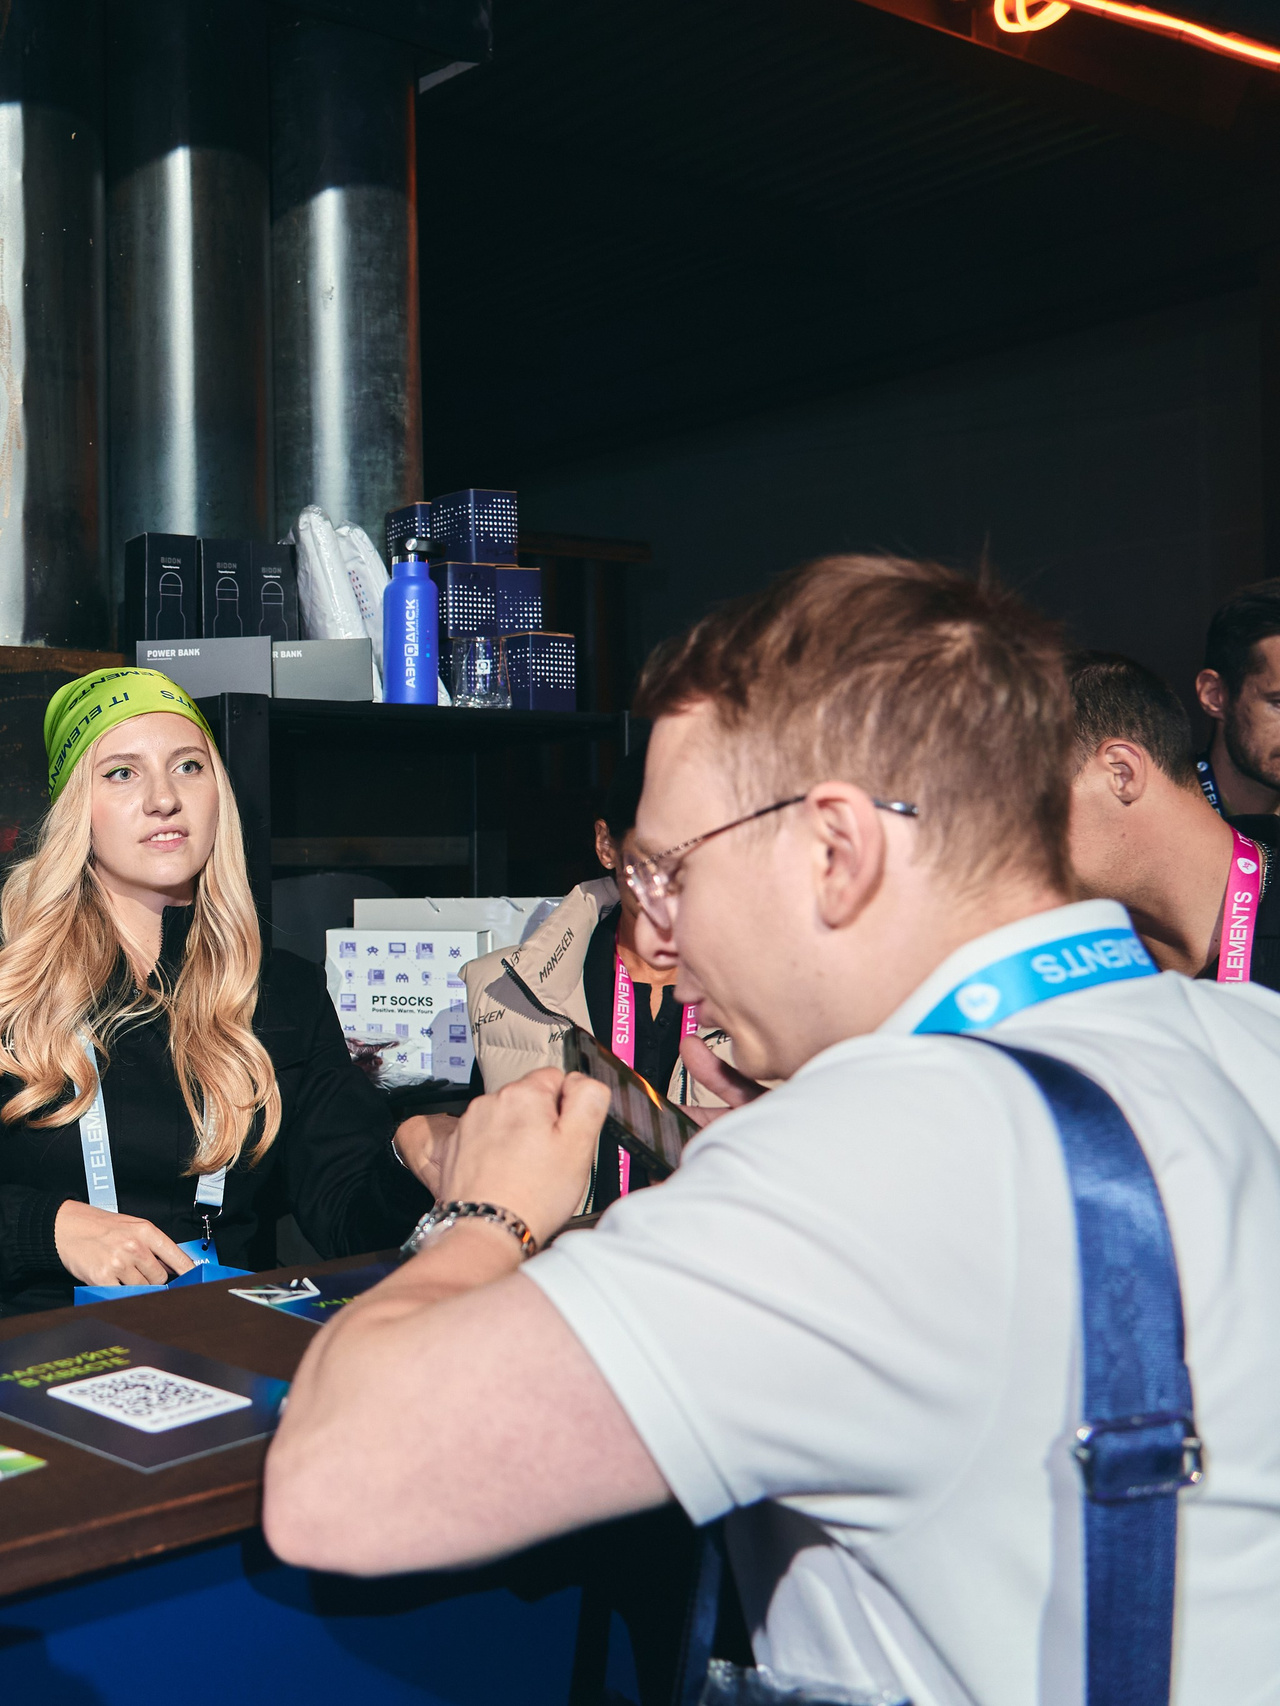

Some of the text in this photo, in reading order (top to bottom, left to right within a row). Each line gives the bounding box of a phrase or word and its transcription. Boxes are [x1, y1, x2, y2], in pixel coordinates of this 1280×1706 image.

[147, 648, 200, 658] POWER BANK
[280, 650, 303, 659] BANK
[48, 692, 130, 797] IT ELEMENT
[1030, 937, 1151, 984] MENTS
[1226, 891, 1253, 985] LEMENTS
[372, 995, 433, 1007] PT SOCKS
[85, 1098, 109, 1191] IT ELEME
